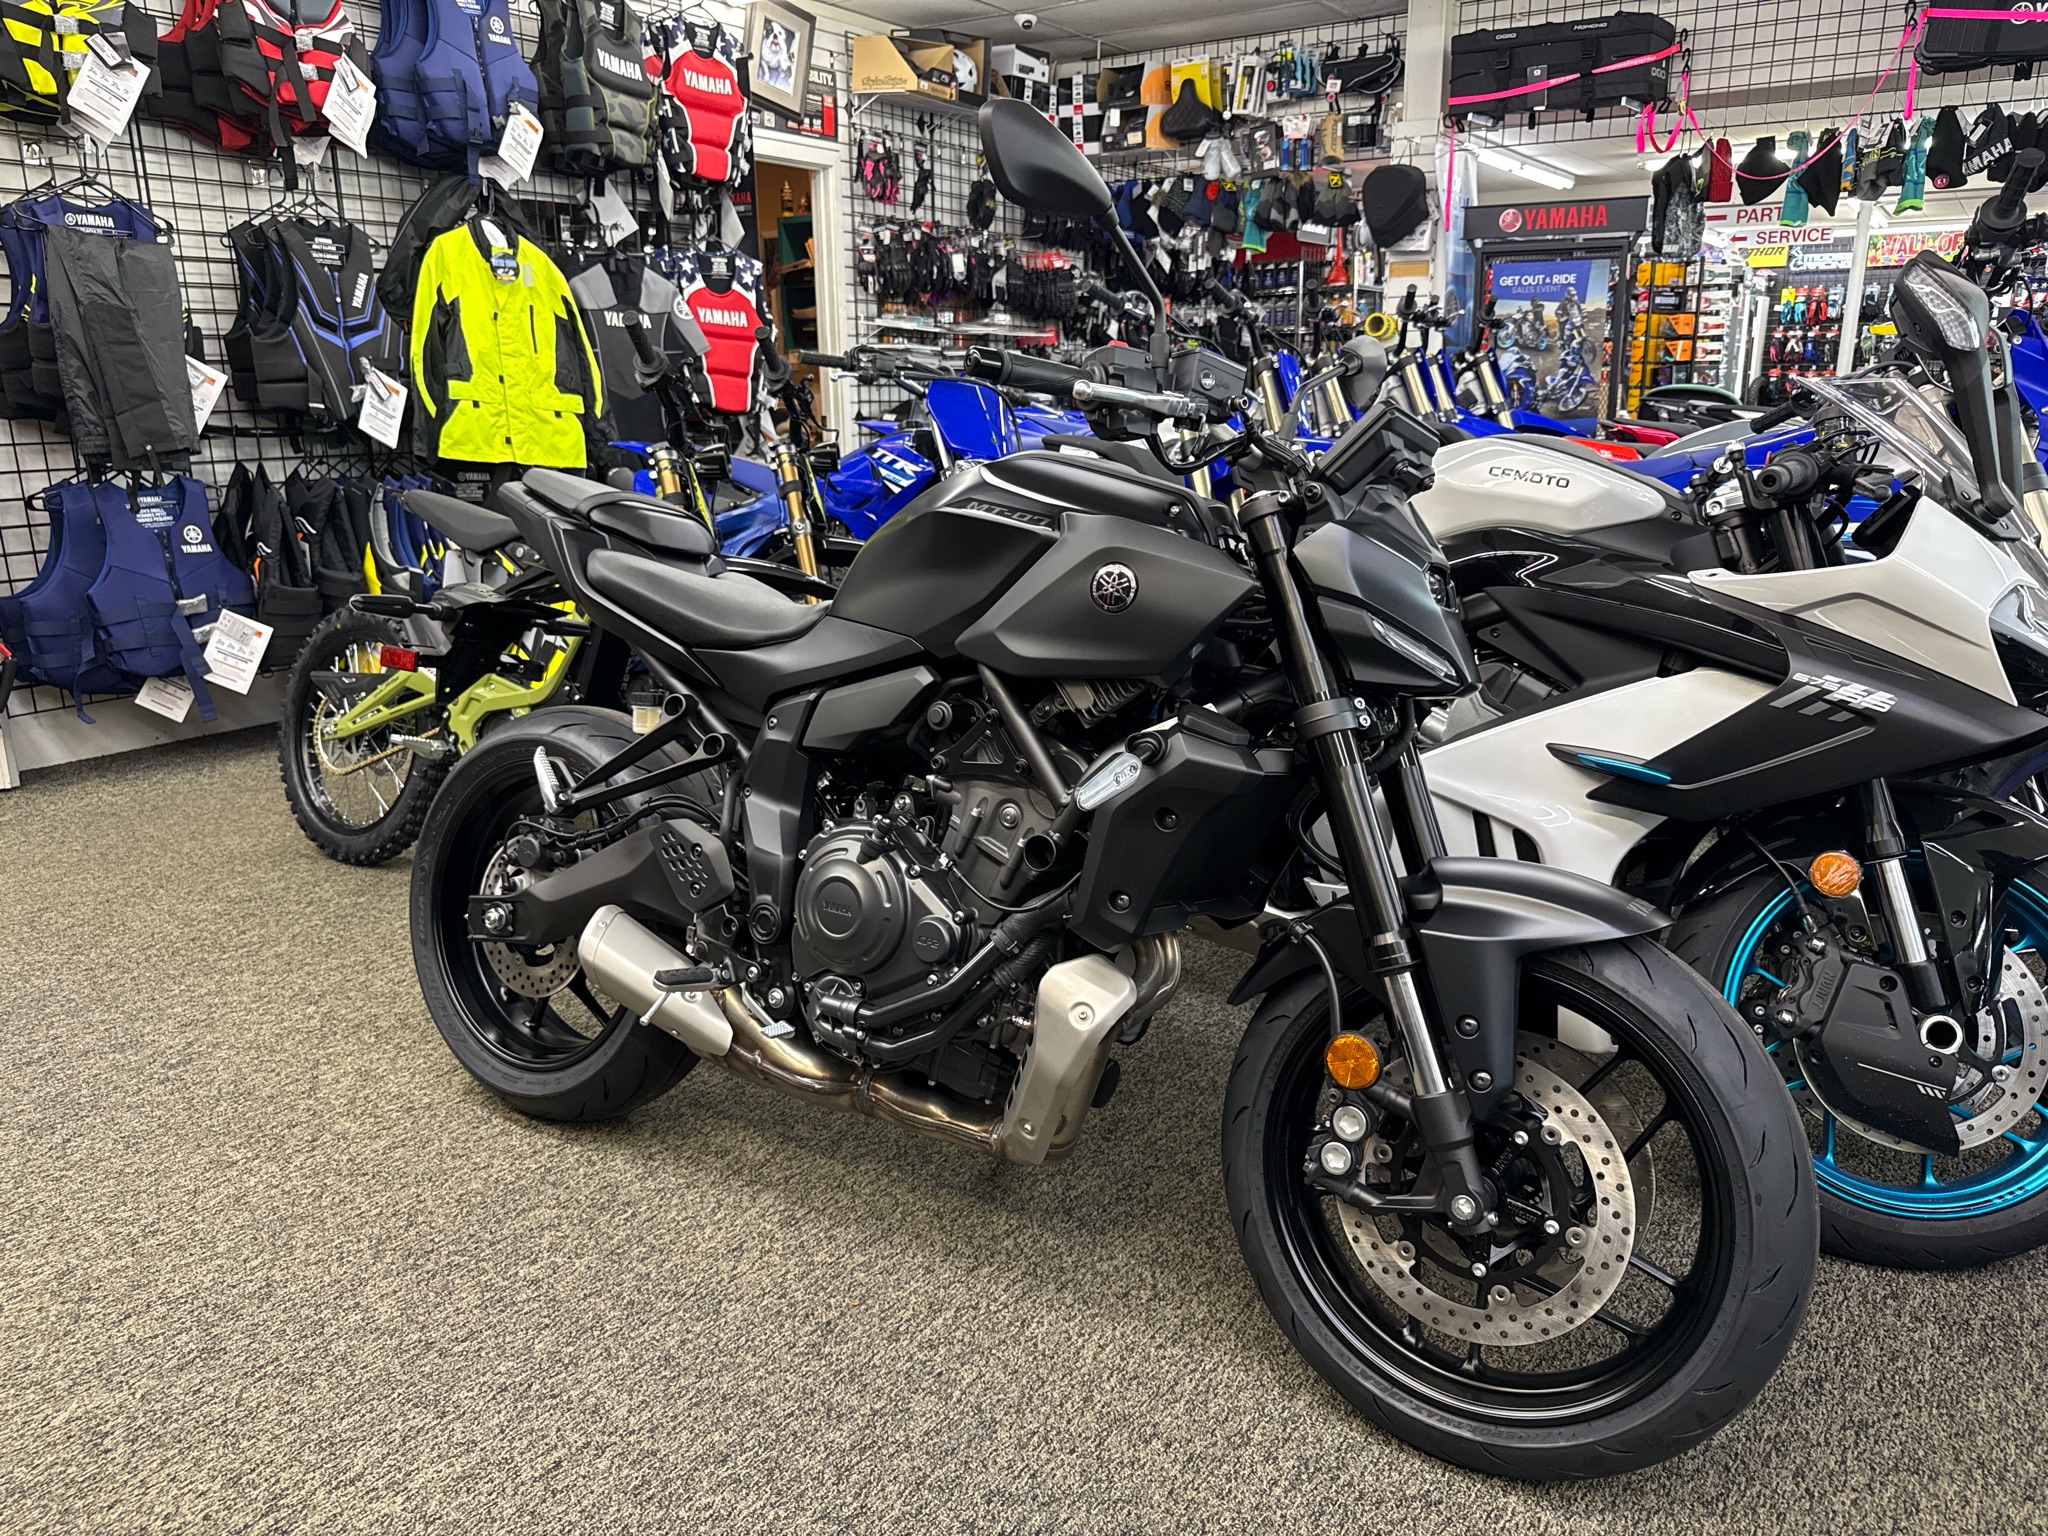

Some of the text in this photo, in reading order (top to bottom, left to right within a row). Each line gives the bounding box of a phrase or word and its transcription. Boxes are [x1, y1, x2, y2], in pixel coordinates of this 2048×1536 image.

[1573, 22, 1608, 31] HONCHO
[488, 33, 511, 45] YAMAHA
[1495, 32, 1517, 40] OGIO
[596, 48, 643, 81] YAMAHA
[683, 68, 733, 95] YAMAHA
[75, 213, 115, 228] YAMAHA
[1524, 204, 1608, 231] YAMAHA
[1756, 227, 1832, 245] SERVICE
[1881, 231, 1964, 256] WALL OF
[1747, 246, 1786, 257] THOR
[1499, 275, 1521, 286] GET
[1521, 275, 1544, 285] OUT
[1552, 273, 1577, 284] RIDE
[351, 272, 369, 309] YAMAHA
[1512, 285, 1561, 294] SALES EVENT
[604, 311, 652, 329] YAA
[697, 307, 749, 327] YAMAHA
[465, 472, 491, 481] YAMAHA
[1488, 466, 1571, 488] CFMOTO
[966, 501, 1053, 526] MT-07
[181, 543, 213, 553] YAMAHA
[1792, 672, 1841, 691] 675
[823, 900, 852, 917] YAMAHA
[1411, 1402, 1519, 1441] SPORTMAX
